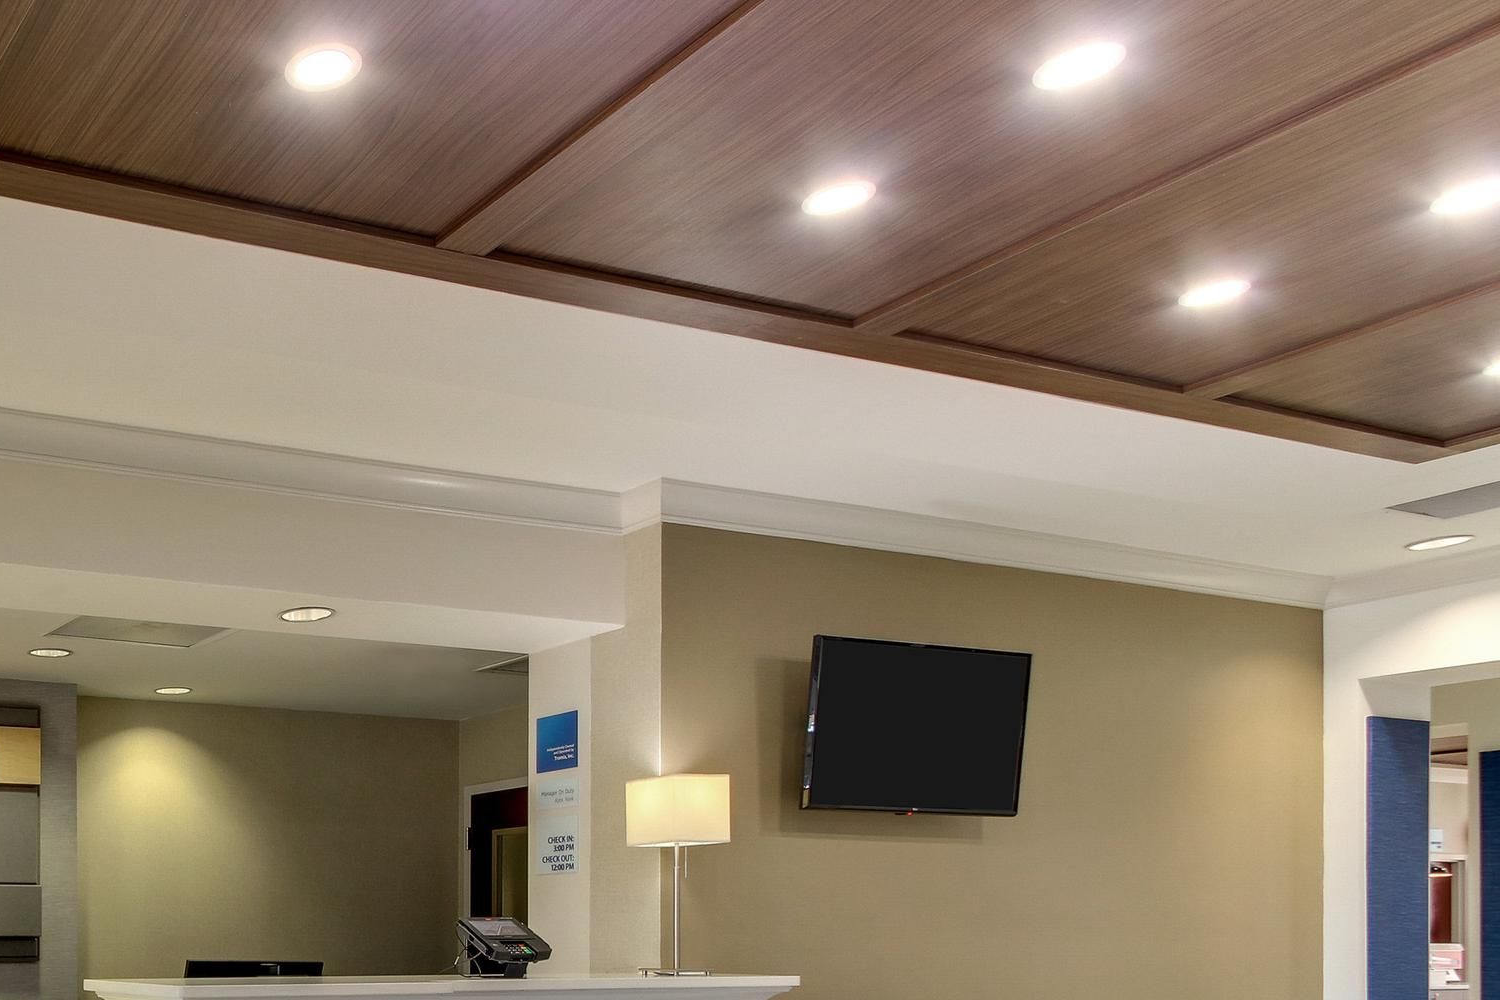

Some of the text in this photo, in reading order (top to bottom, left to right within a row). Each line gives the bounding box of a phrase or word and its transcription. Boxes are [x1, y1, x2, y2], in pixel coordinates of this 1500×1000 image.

[548, 836, 566, 844] CHECK
[554, 844, 565, 852] 3:00
[551, 863, 565, 871] 12:00
